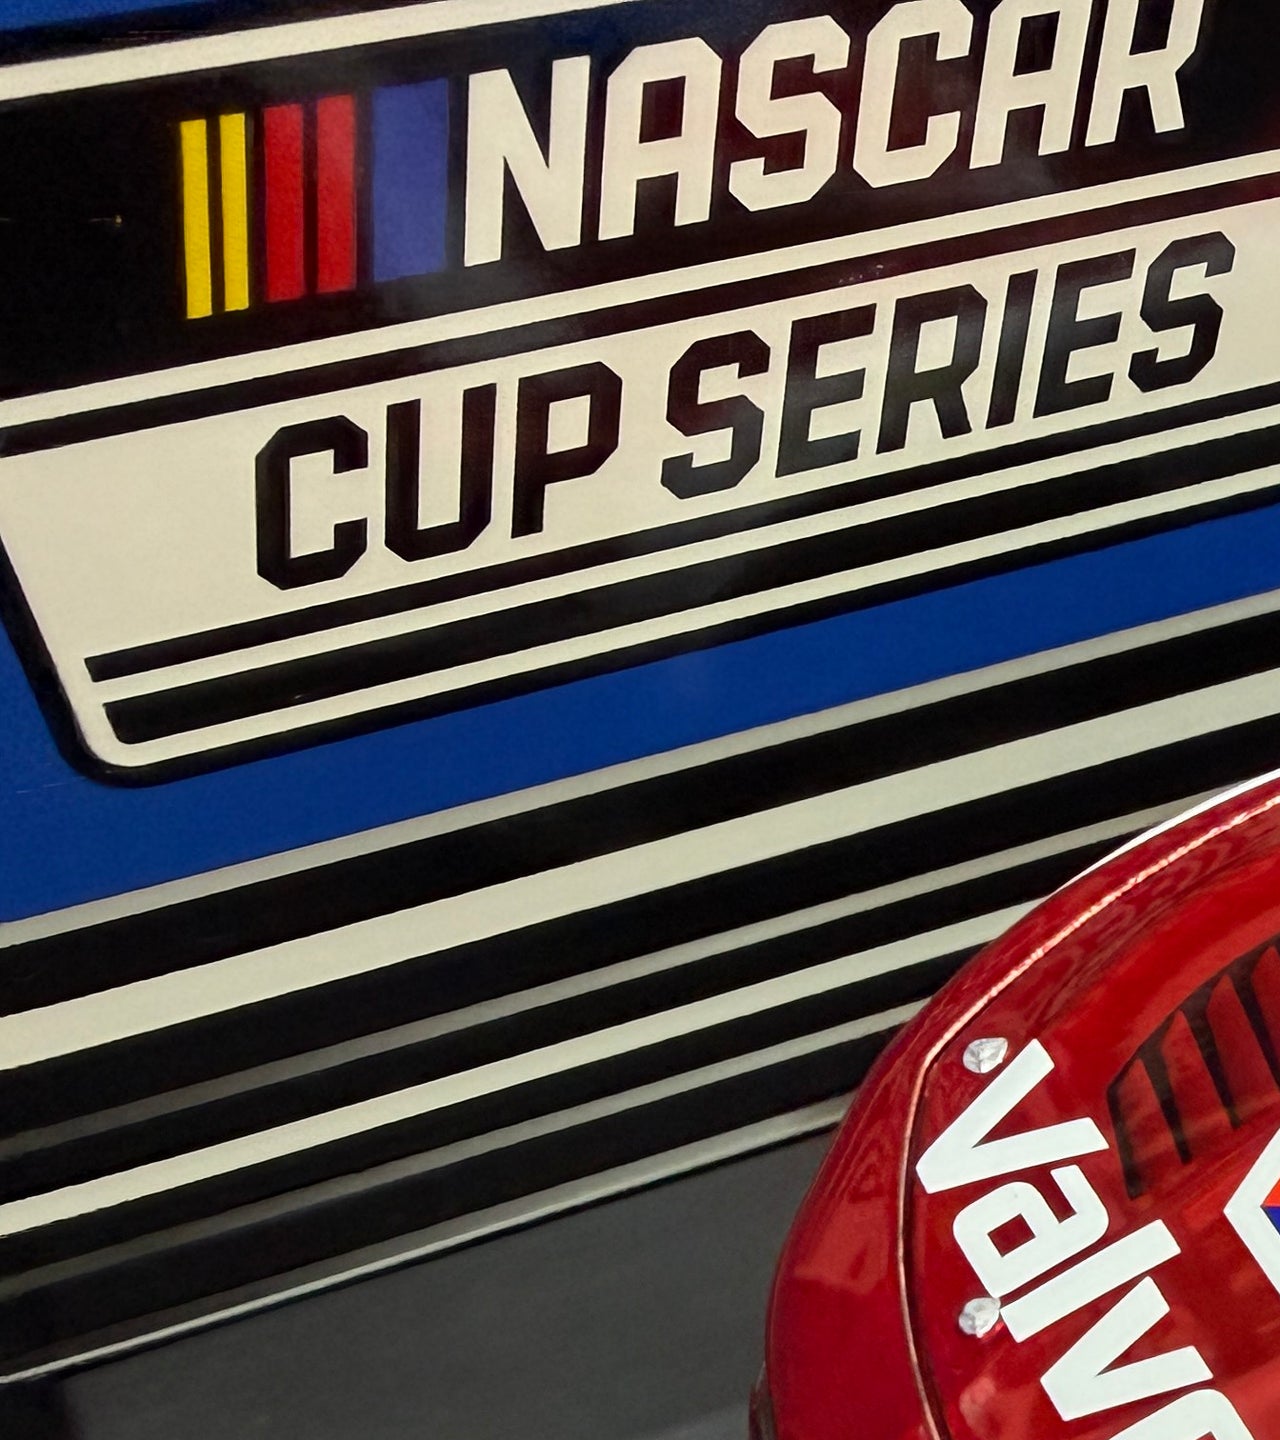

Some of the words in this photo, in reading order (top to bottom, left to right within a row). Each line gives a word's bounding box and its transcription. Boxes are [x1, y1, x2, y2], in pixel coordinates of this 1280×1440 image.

[463, 0, 1201, 268] NASCAR
[255, 360, 623, 591] CUP
[659, 231, 1236, 500] SERIES
